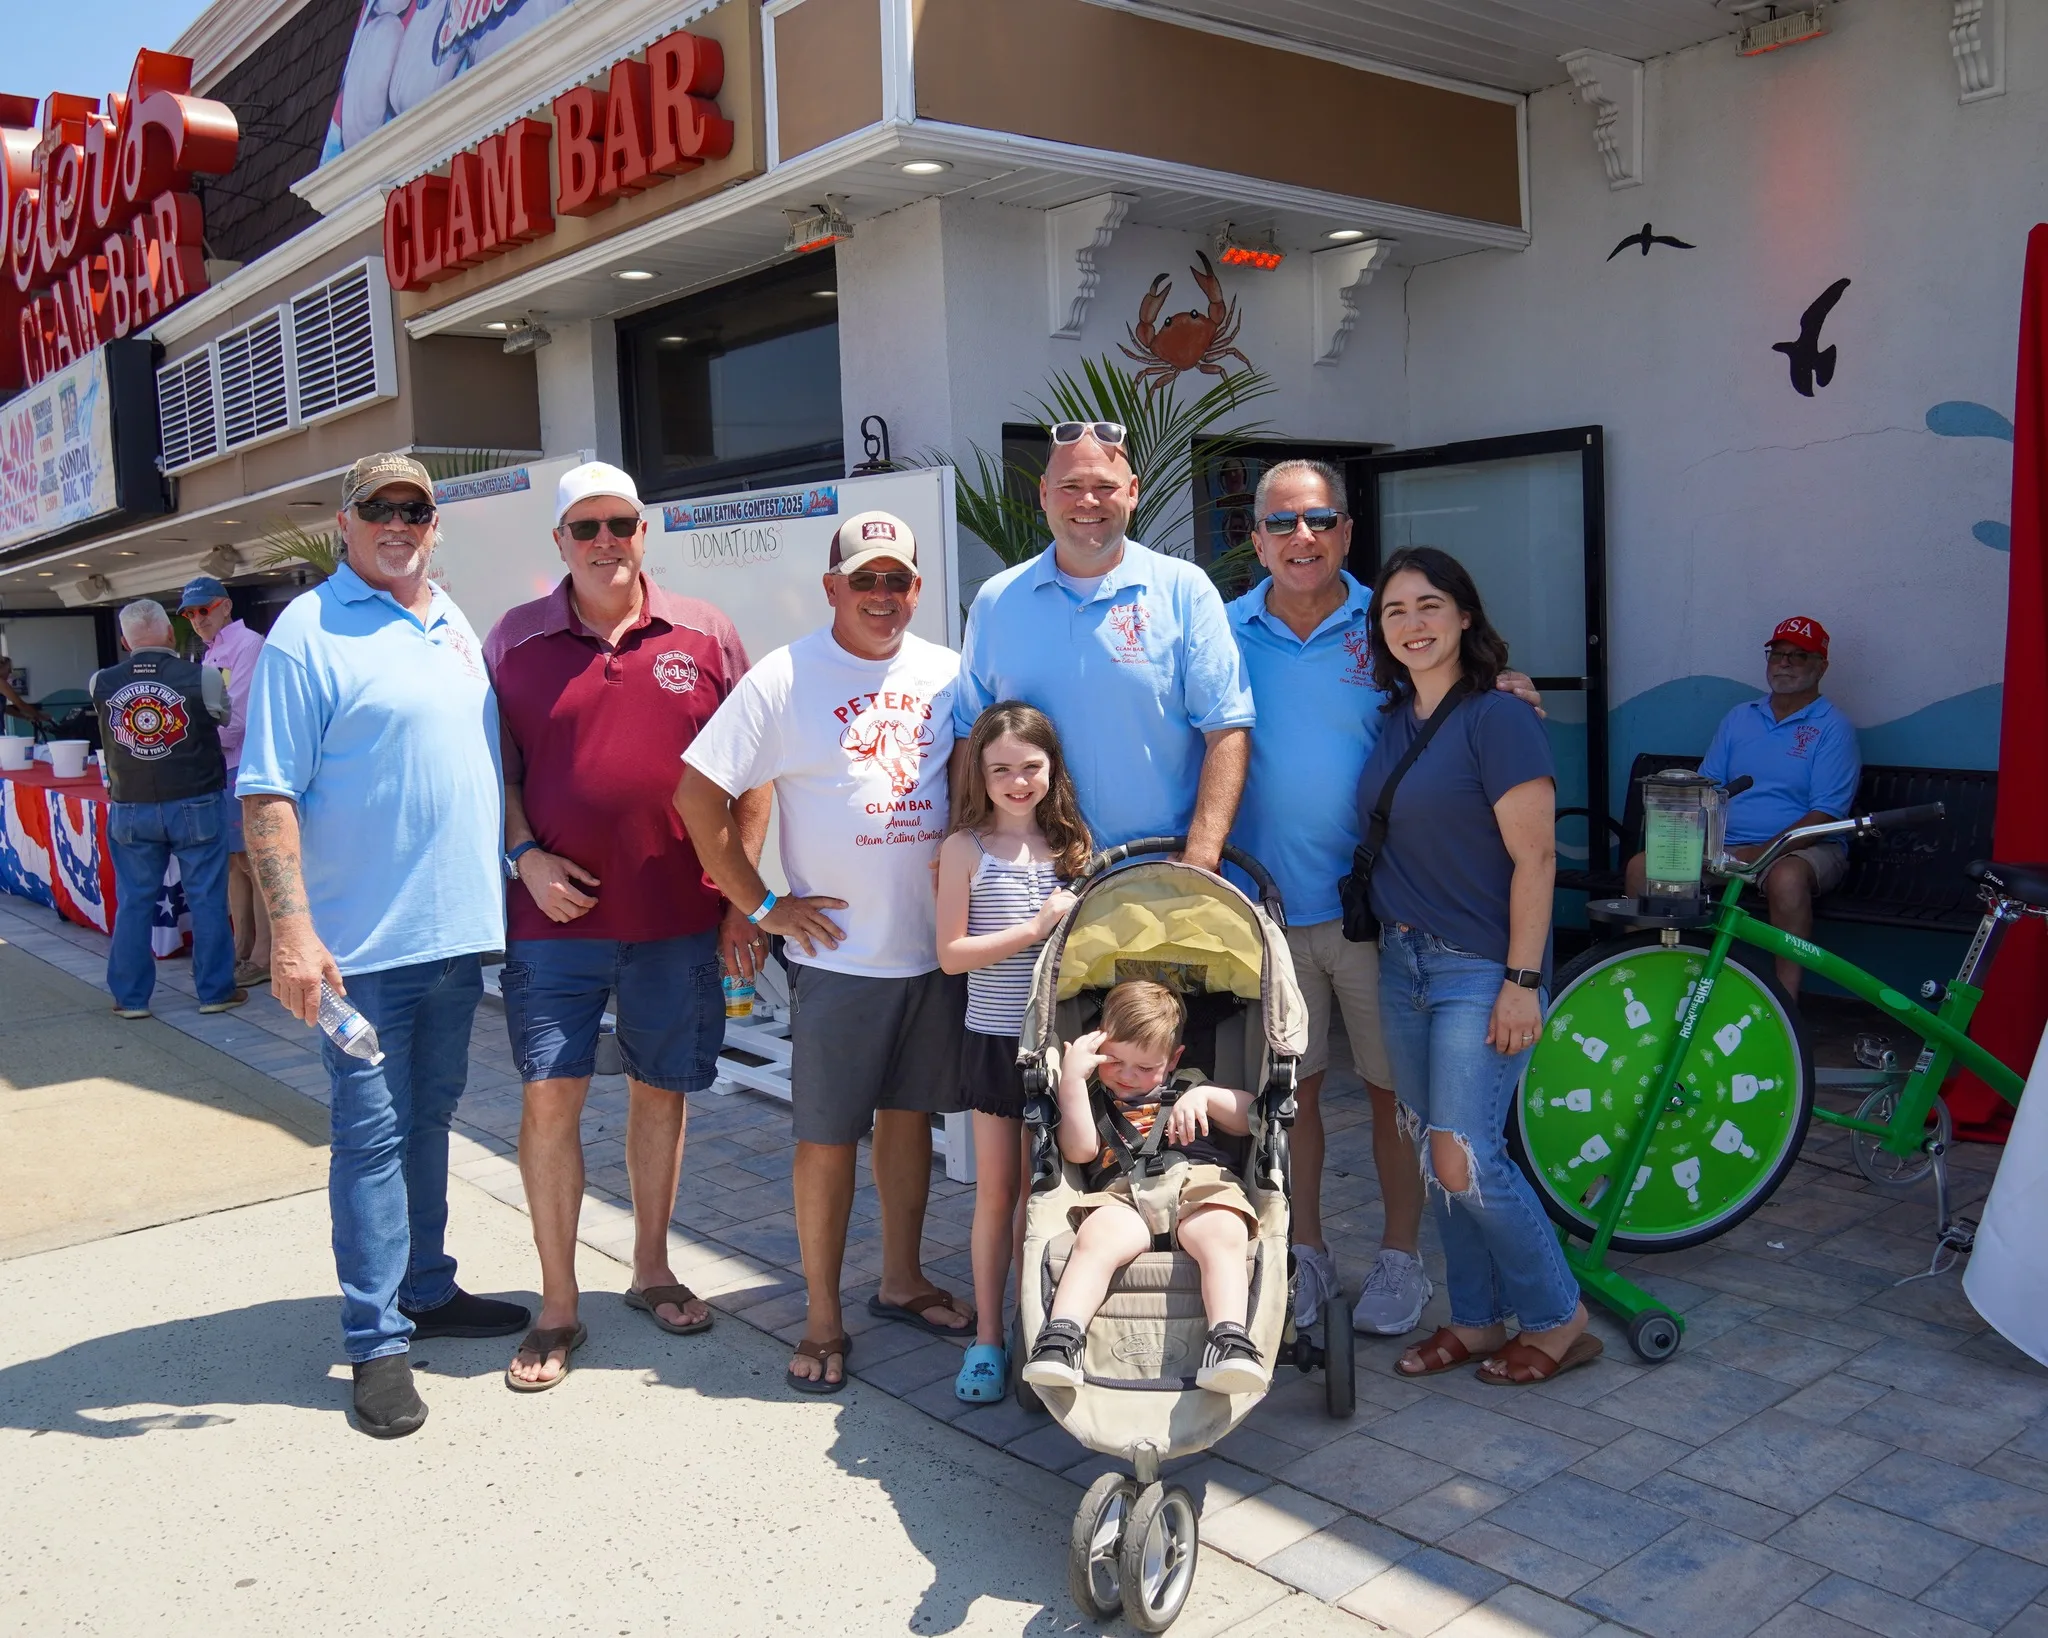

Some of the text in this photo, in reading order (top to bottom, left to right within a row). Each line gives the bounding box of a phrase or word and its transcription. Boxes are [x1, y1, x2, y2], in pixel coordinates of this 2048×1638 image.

[384, 30, 733, 292] CLAM BAR
[20, 190, 195, 388] CLAM BAR
[0, 408, 34, 473] LAM
[58, 443, 91, 482] SUNDAY
[380, 457, 409, 466] LAKE
[62, 479, 80, 506] AUG.
[446, 484, 459, 498] CLAM
[459, 481, 477, 497] EATING
[476, 477, 497, 494] CONTEST
[497, 475, 511, 490] 2025
[693, 495, 803, 524] CLAM EATING CONTEST 2025
[866, 523, 893, 538] 211
[690, 527, 777, 562] DONATIONS
[1111, 605, 1151, 618] PETER'S
[1778, 620, 1812, 638] USA
[116, 685, 150, 707] FIGHTERS
[157, 687, 176, 706] FIRE
[833, 691, 933, 724] PETER'S
[136, 746, 166, 755] NEW YORK
[866, 799, 933, 815] CLAM BAR
[885, 816, 922, 829] Annual
[855, 828, 944, 847] Clam Eating Contest
[1679, 1012, 1698, 1039] ROCK
[1692, 976, 1711, 1004] BIKE
